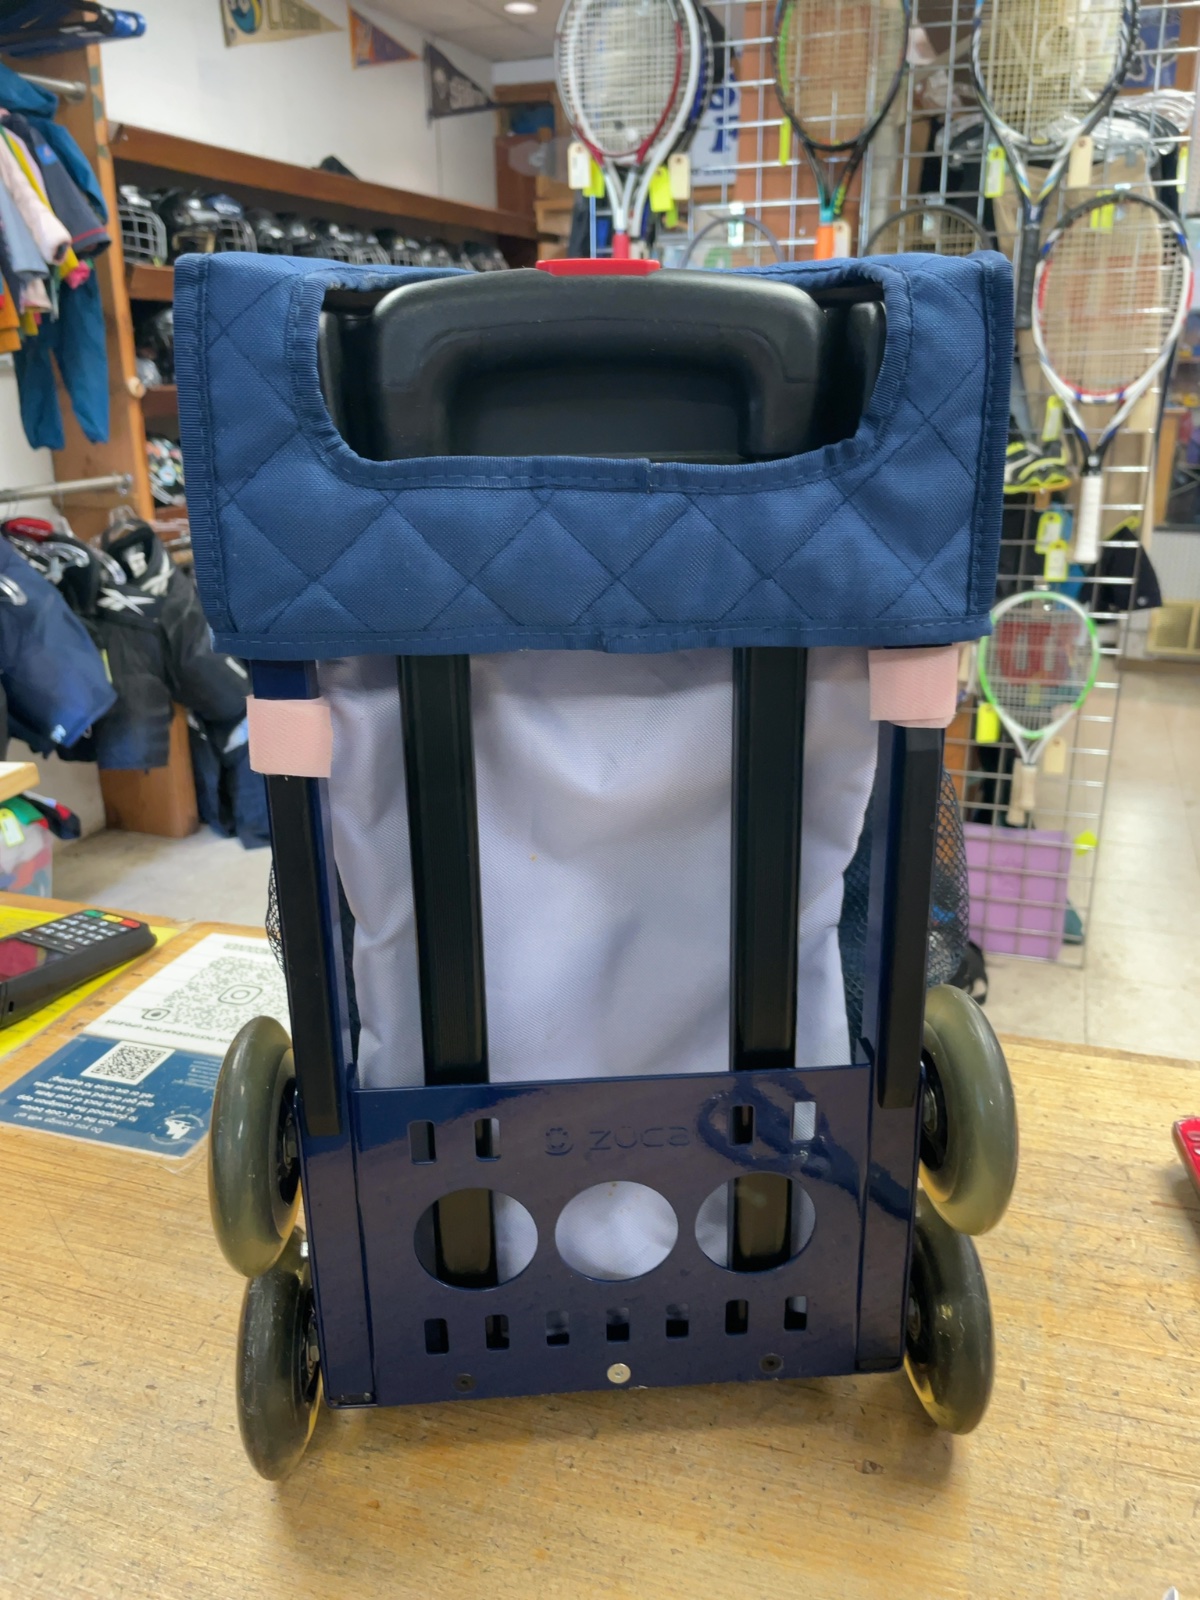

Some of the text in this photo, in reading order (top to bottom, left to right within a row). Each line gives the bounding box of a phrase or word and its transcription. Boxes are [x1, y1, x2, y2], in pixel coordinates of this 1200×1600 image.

[54, 1085, 73, 1093] your
[93, 1083, 115, 1093] close
[55, 1093, 75, 1101] your
[121, 1096, 138, 1105] get
[82, 1098, 105, 1108] track
[104, 1102, 127, 1112] keep
[136, 1099, 156, 1108] and
[73, 1105, 89, 1113] the
[86, 1107, 128, 1120] download
[127, 1106, 137, 1114] to
[19, 1104, 118, 1128] Scan the QR Code below
[27, 1114, 44, 1122] with
[128, 1114, 139, 1123] to
[74, 1123, 92, 1131] you
[90, 1126, 104, 1134] Do
